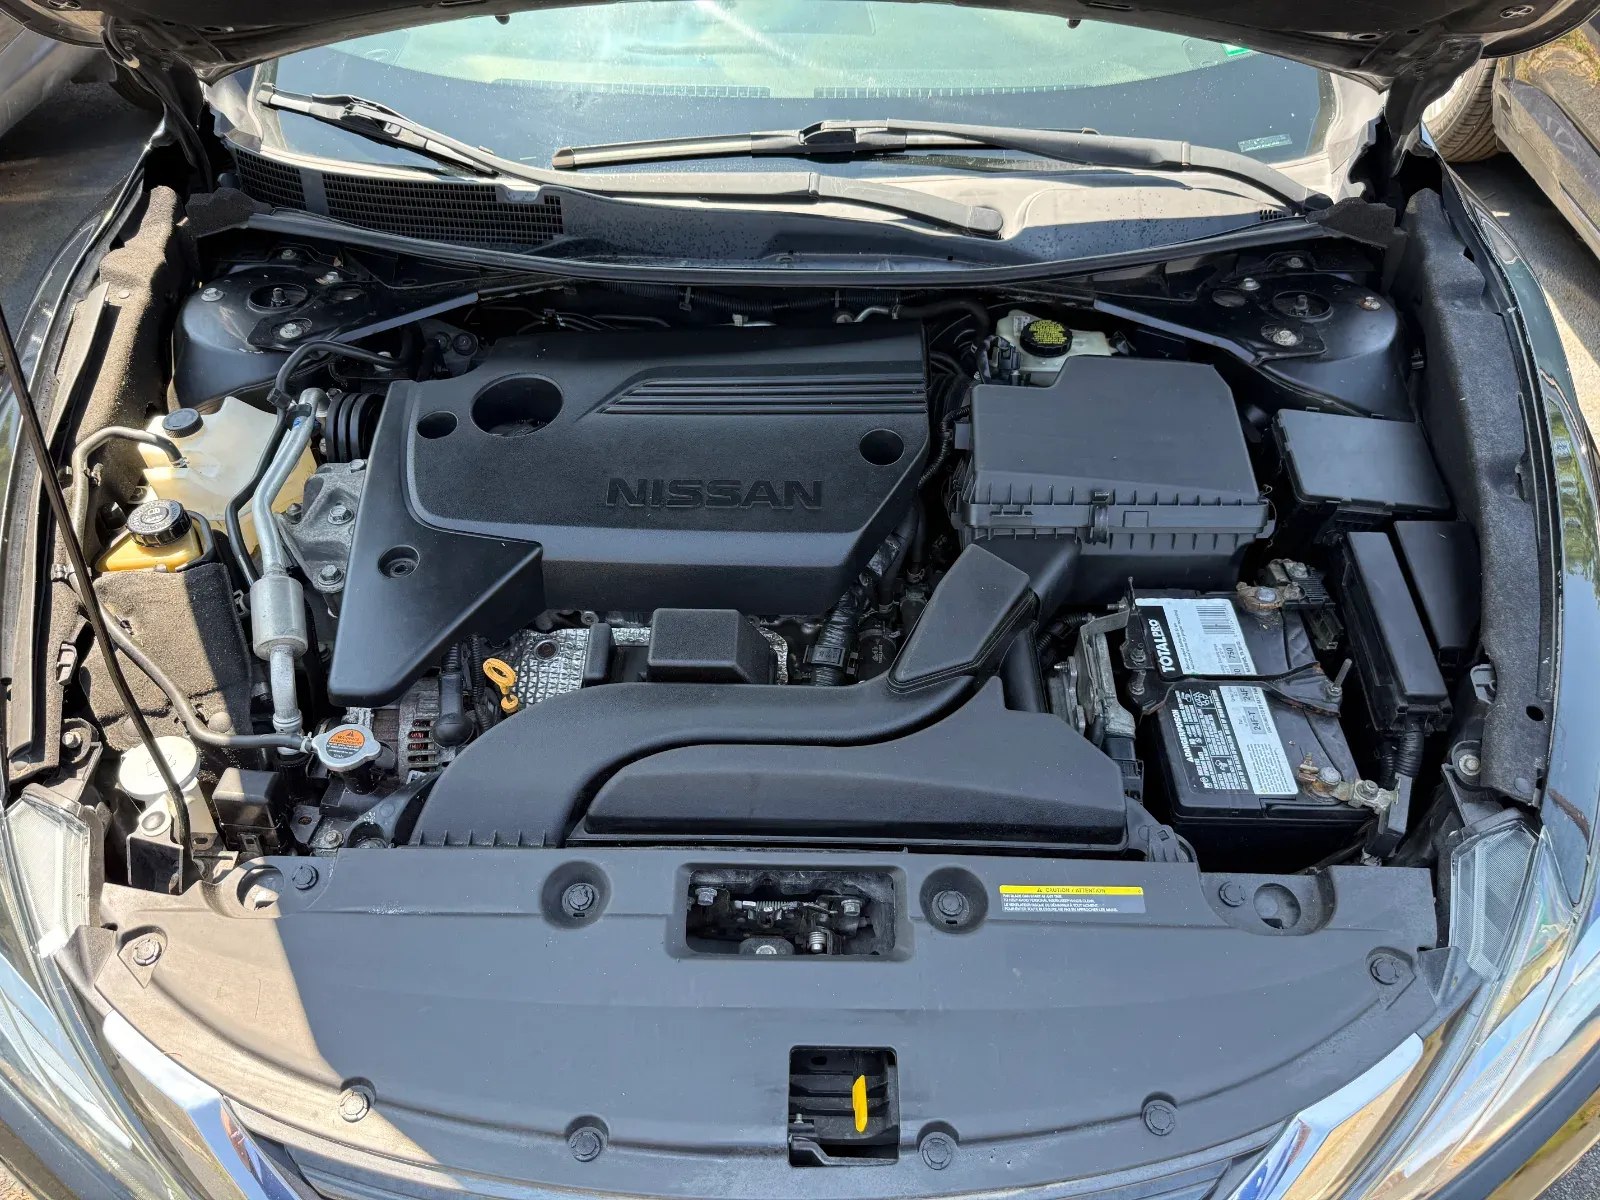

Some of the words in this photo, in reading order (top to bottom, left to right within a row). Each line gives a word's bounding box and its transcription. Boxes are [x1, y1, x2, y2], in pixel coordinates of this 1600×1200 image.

[605, 477, 823, 510] NISSAN
[1149, 619, 1176, 673] TOTALPRO
[1225, 647, 1236, 659] 750
[1240, 688, 1251, 702] 24F
[1247, 710, 1261, 731] 24F-T
